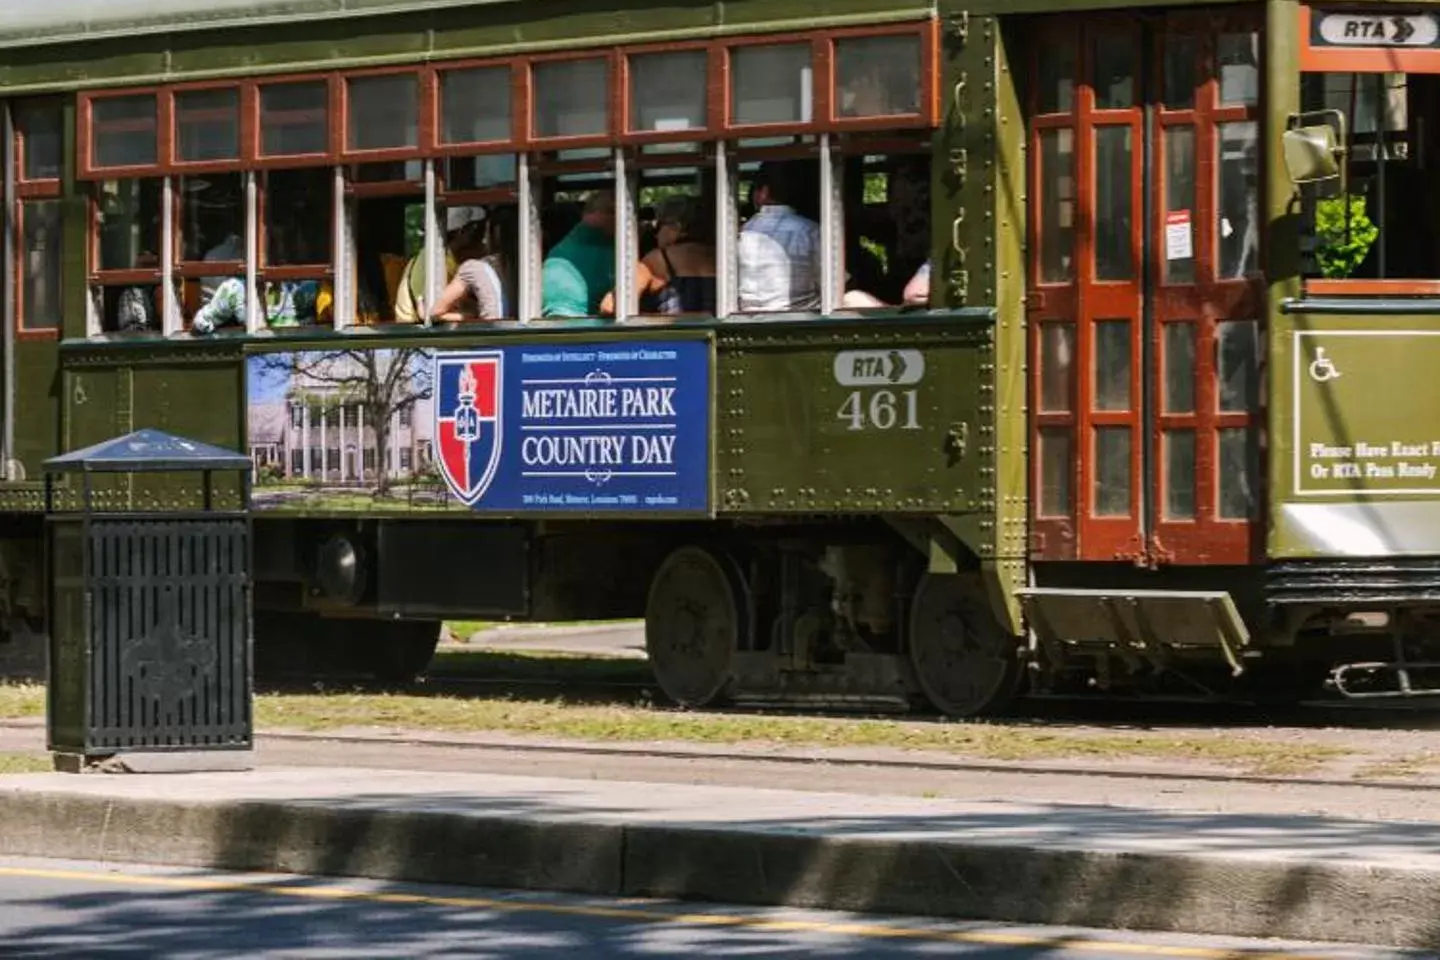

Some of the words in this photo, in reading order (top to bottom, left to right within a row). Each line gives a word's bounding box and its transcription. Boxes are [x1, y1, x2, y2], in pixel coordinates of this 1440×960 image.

[1343, 20, 1384, 38] RTA
[852, 357, 885, 378] RTA
[522, 388, 617, 418] METAIRIE
[622, 387, 677, 416] PARK
[836, 389, 924, 431] 461
[521, 435, 626, 465] COUNTRY
[631, 435, 677, 464] DAY
[1310, 442, 1352, 457] Please
[1355, 442, 1388, 457] Have
[1391, 441, 1428, 456] Exact
[1310, 464, 1329, 478] Or
[1332, 463, 1361, 478] RTA
